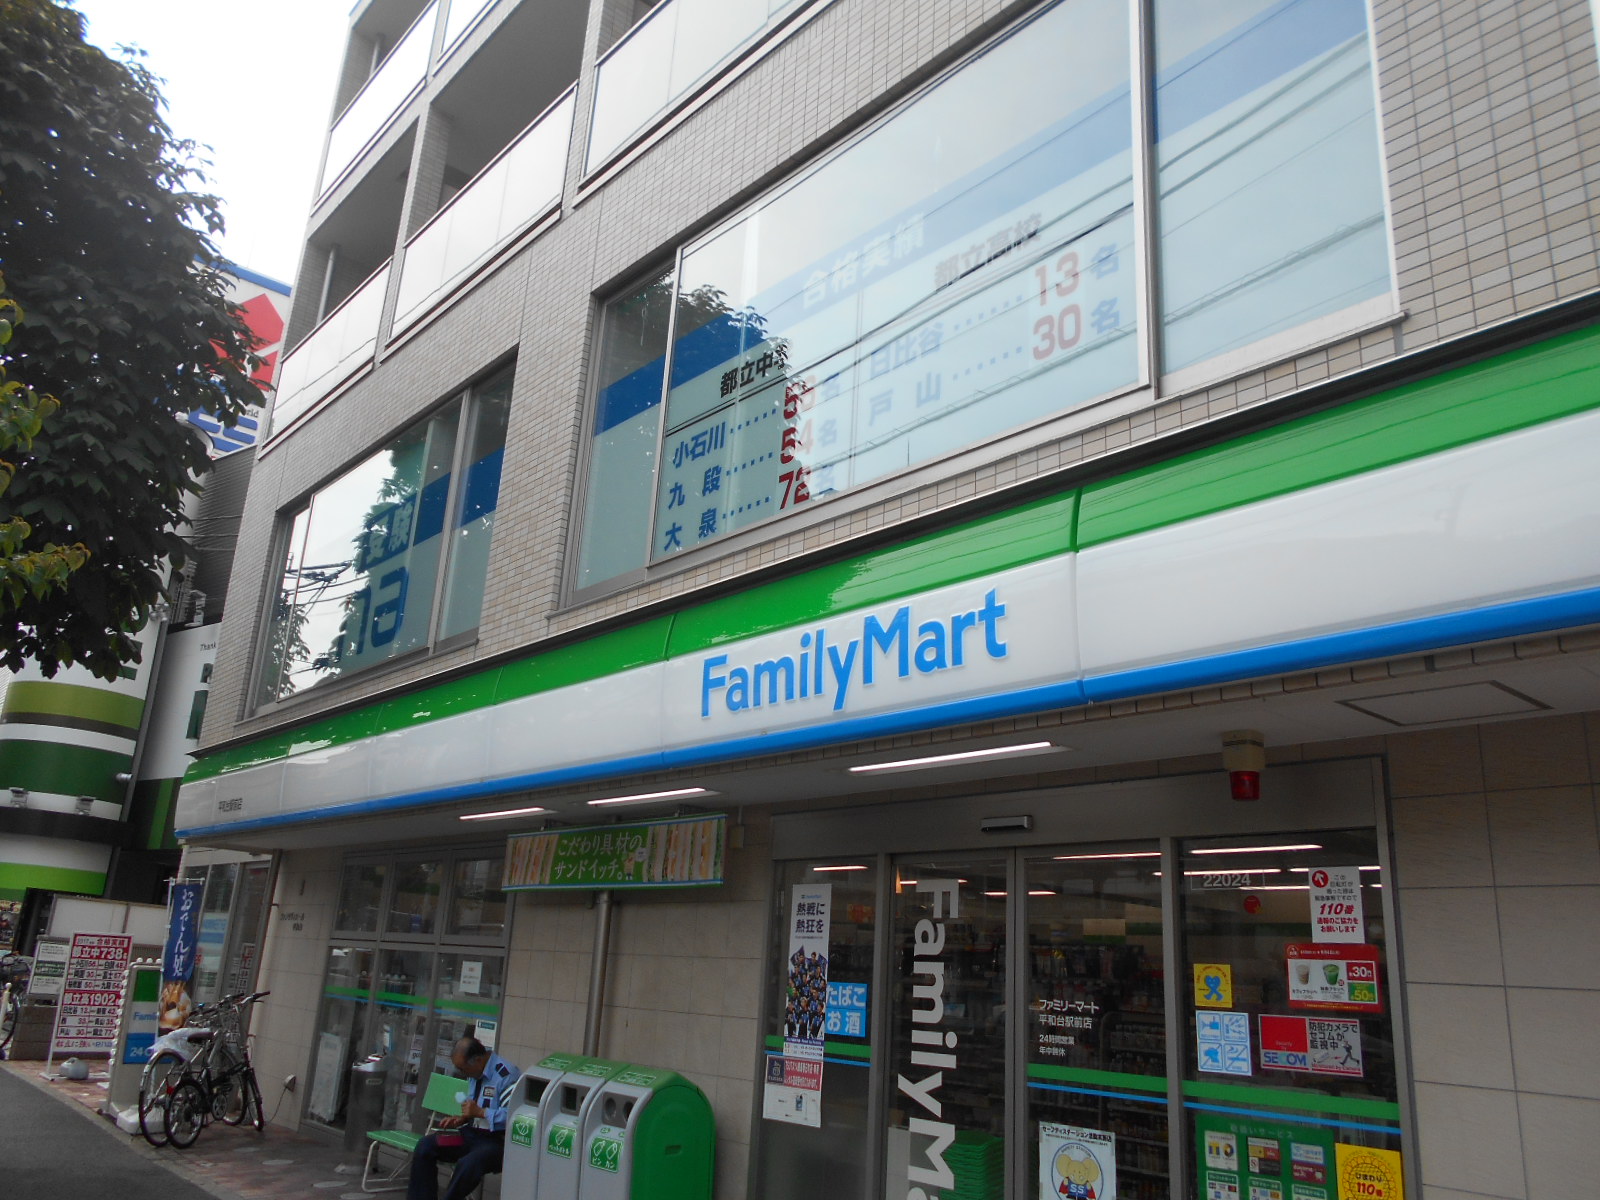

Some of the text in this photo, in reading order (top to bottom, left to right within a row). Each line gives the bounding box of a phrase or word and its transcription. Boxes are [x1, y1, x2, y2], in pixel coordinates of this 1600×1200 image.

[934, 213, 1043, 292] 都立高校
[803, 221, 926, 308] 合格実績
[672, 421, 727, 468] 小石川
[701, 588, 1008, 718] FamilyMart
[557, 832, 643, 857] こだわり具材の
[1203, 873, 1252, 888] 22024
[796, 902, 826, 917] 熱戦に
[1319, 902, 1355, 916] 110番
[795, 918, 824, 934] 熱狂を
[1317, 916, 1360, 925] 通報のご協力を
[1320, 925, 1357, 933] お願いします
[826, 985, 867, 1008] たばこ
[1039, 999, 1099, 1014] ファミリーマート
[827, 1010, 861, 1035] お酒
[1039, 1014, 1093, 1029] 平和台駅前店
[1309, 1022, 1358, 1034] 防犯カメラで
[1309, 1031, 1345, 1042] セコムが
[1310, 1040, 1339, 1050] 監視中
[1264, 1052, 1307, 1067] SECOM
[1355, 1172, 1384, 1183] ひまわり
[1070, 1183, 1085, 1194] SS
